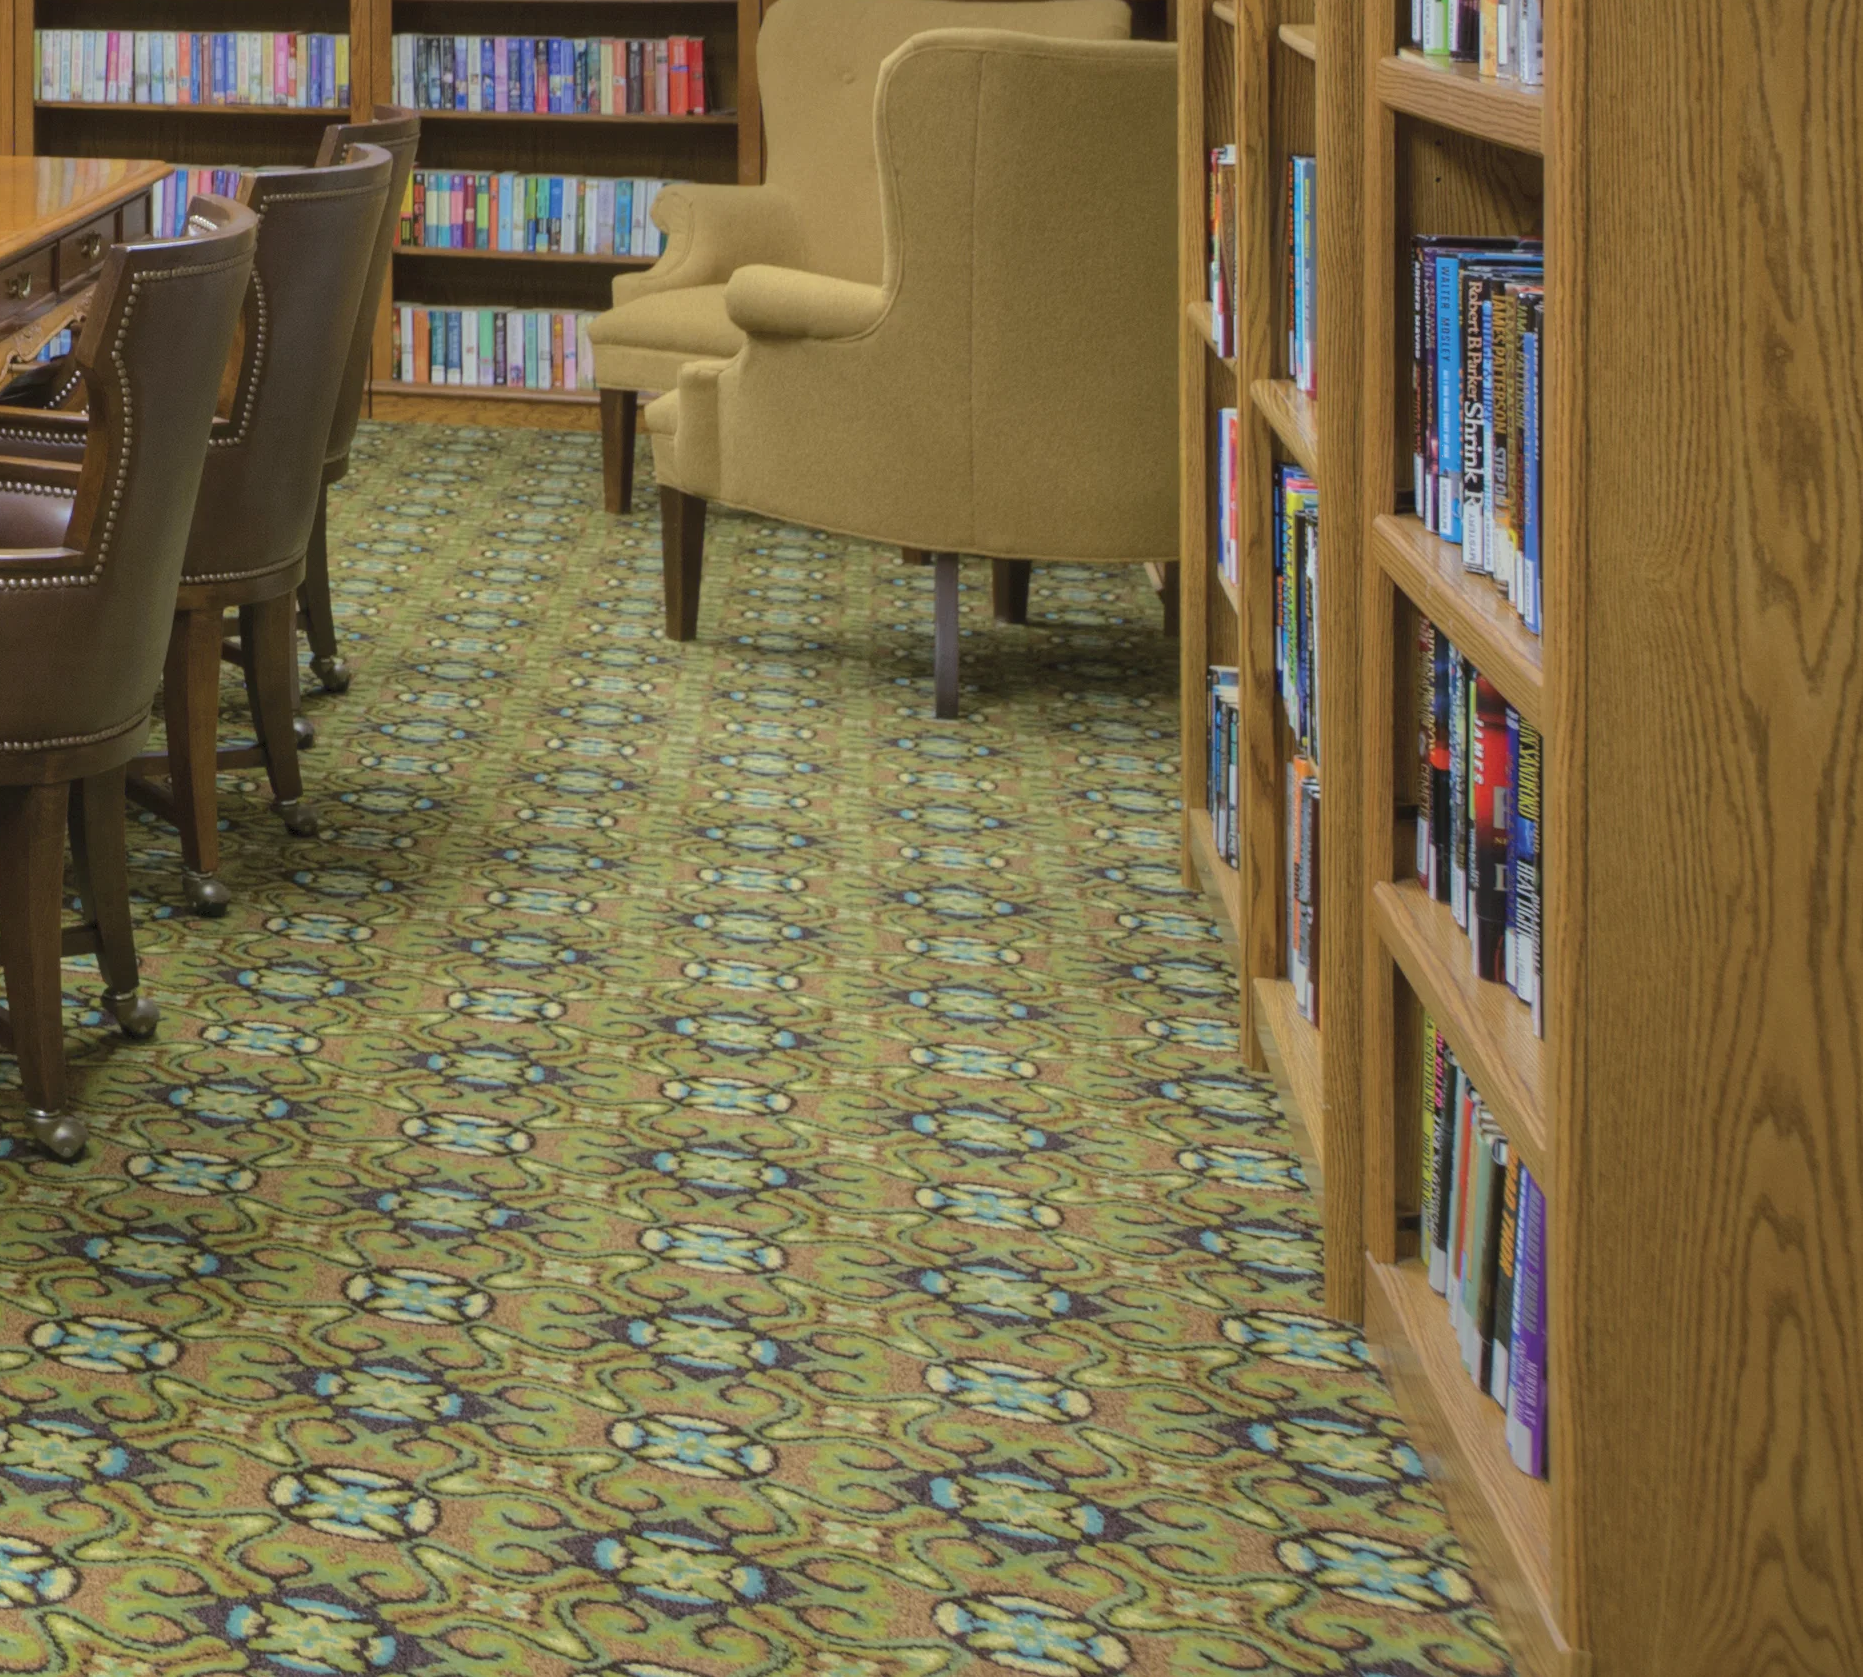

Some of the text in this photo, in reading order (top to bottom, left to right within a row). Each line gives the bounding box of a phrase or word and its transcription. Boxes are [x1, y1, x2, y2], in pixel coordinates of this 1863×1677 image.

[1441, 266, 1451, 361] WALTER MOSLEY
[1468, 282, 1482, 334] Robert
[1467, 352, 1481, 401] Parker
[1492, 292, 1507, 506] JAMES PATTERSON STEP ON
[1464, 401, 1484, 482] Shrink
[1519, 745, 1537, 820] SANDFORD
[1517, 861, 1536, 898] HEAT
